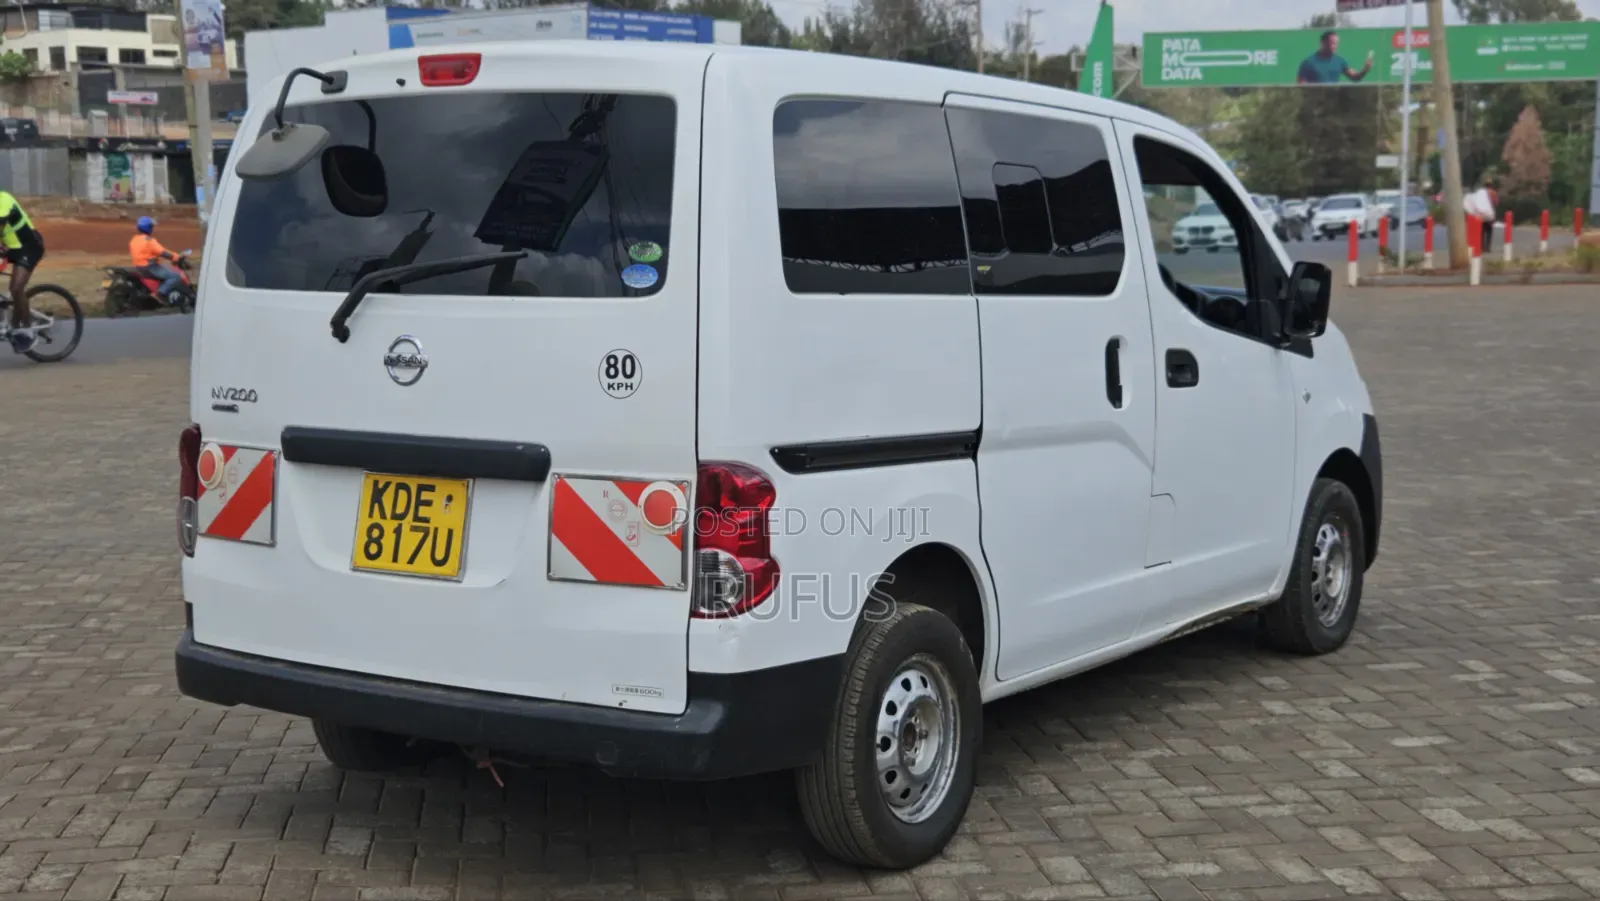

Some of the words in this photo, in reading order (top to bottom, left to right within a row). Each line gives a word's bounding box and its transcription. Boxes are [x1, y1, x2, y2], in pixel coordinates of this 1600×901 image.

[1162, 38, 1201, 51] PATA
[1162, 50, 1278, 66] MORE
[1161, 67, 1203, 80] DATA
[387, 354, 423, 366] NISSAN
[605, 354, 636, 380] 80
[211, 386, 258, 403] NV200
[607, 382, 634, 391] KPH
[368, 480, 437, 524] KDE
[363, 522, 454, 567] 817U
